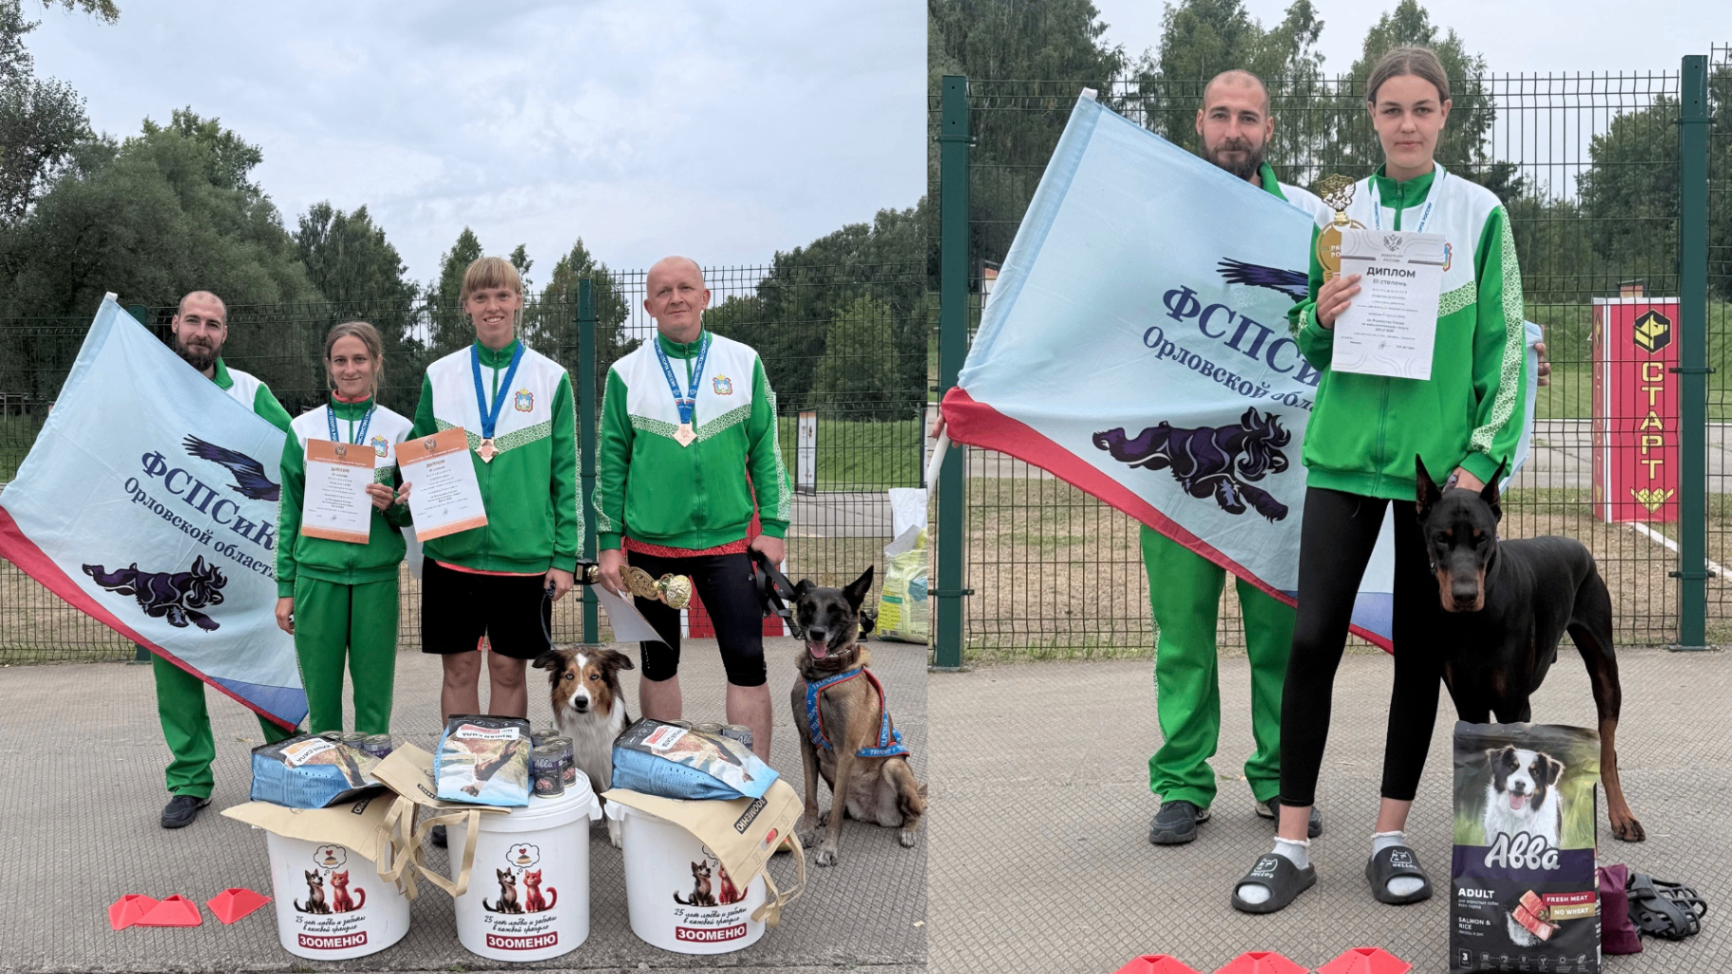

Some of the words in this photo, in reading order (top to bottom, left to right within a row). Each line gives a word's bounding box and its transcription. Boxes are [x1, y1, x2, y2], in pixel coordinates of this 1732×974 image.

[1366, 266, 1416, 278] ДИПЛОМ
[1162, 285, 1322, 388] ФСПСи
[1143, 326, 1271, 399] Орловской
[1639, 362, 1664, 480] СТАРТ
[141, 450, 275, 551] ФСПСиК
[124, 477, 213, 545] Орловской
[1458, 888, 1495, 899] ADULT
[674, 908, 685, 916] 25
[1566, 907, 1589, 915] WHEAT
[1458, 917, 1484, 925] SALMON
[678, 926, 745, 940] ЗООМЕНЮ
[300, 934, 365, 948] ЗООМЕНЮ
[488, 934, 556, 948] ЗООМЕНЮ
[1462, 952, 1468, 961] 3
